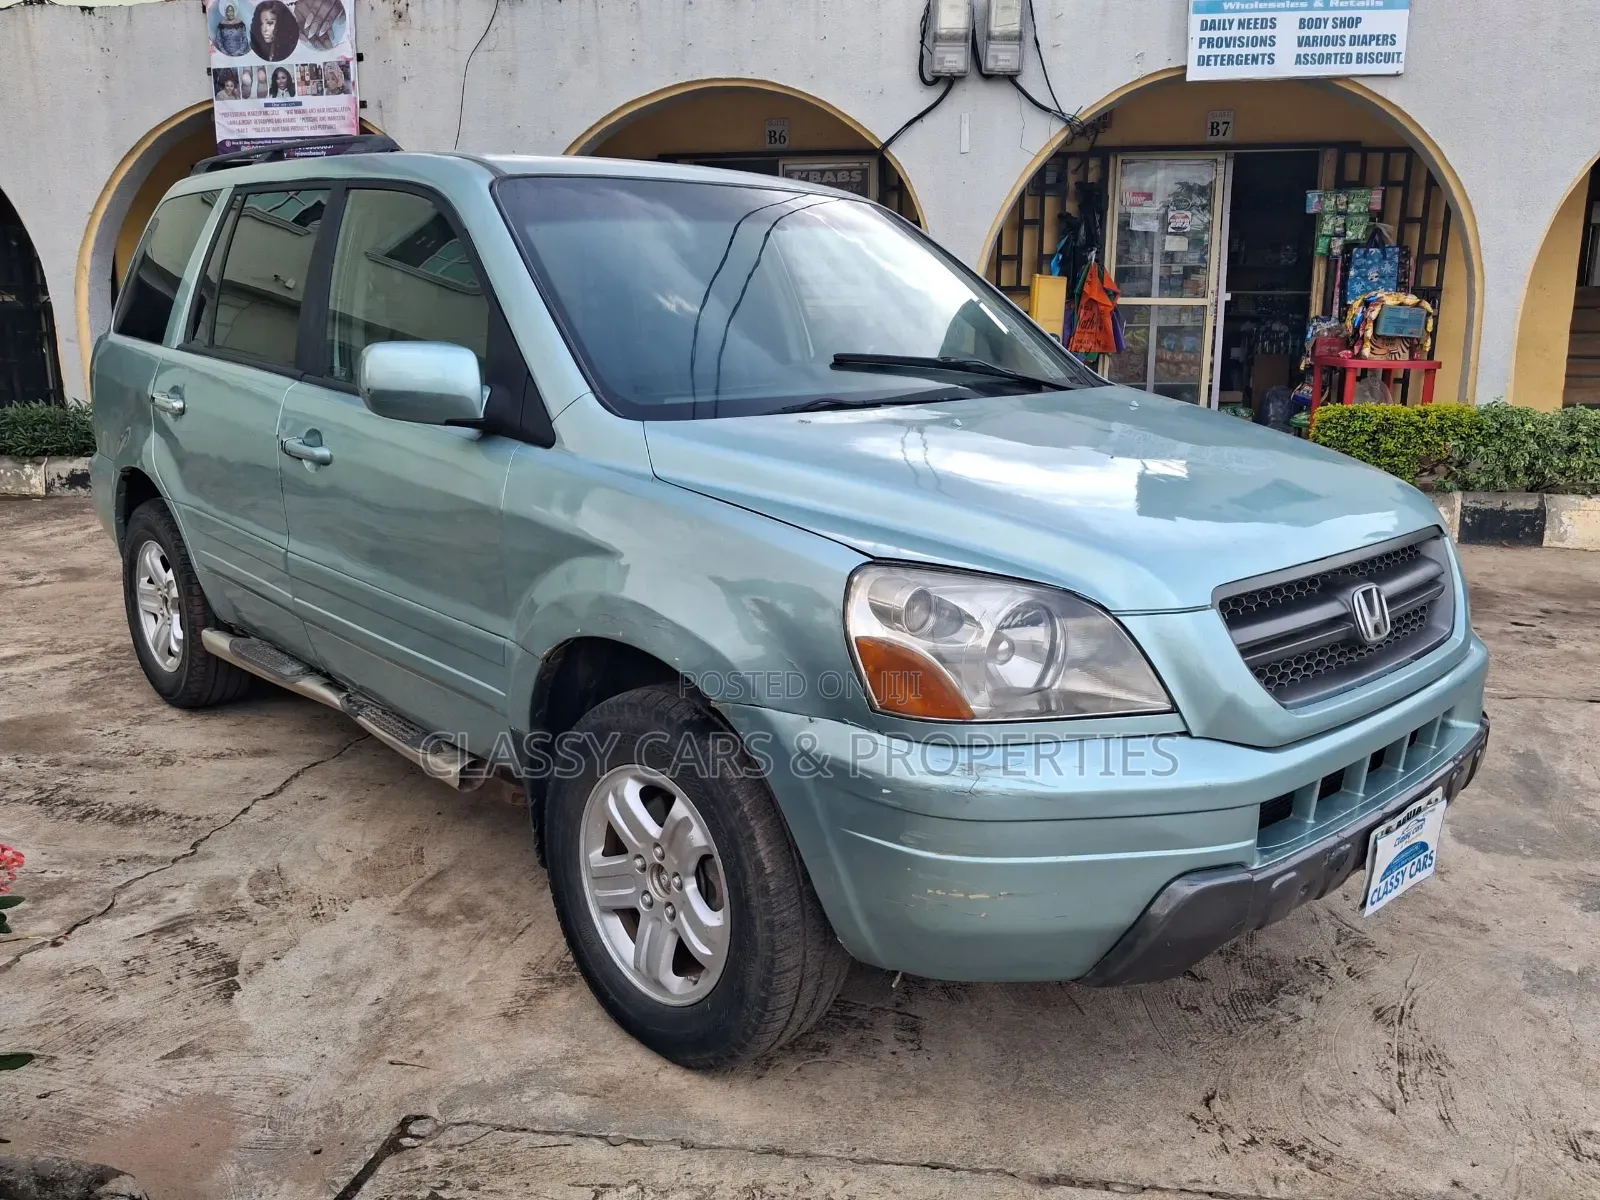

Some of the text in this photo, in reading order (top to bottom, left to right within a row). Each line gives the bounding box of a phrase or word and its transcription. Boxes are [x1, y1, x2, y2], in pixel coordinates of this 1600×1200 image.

[1223, 0, 1308, 10] Wholesales
[1200, 17, 1277, 31] DAILY NEEDS
[1298, 16, 1362, 29] BODY SHOP
[1199, 35, 1277, 49] PROVISIONS
[1297, 33, 1397, 48] VARIOUS DIAPERS
[1197, 52, 1275, 67] DETERGENTS
[1294, 51, 1403, 66] ASSORTED BISCUIT.
[1209, 121, 1231, 137] B7
[767, 129, 787, 145] B6
[1370, 866, 1408, 906] CLASSY
[1409, 850, 1434, 879] CARS
